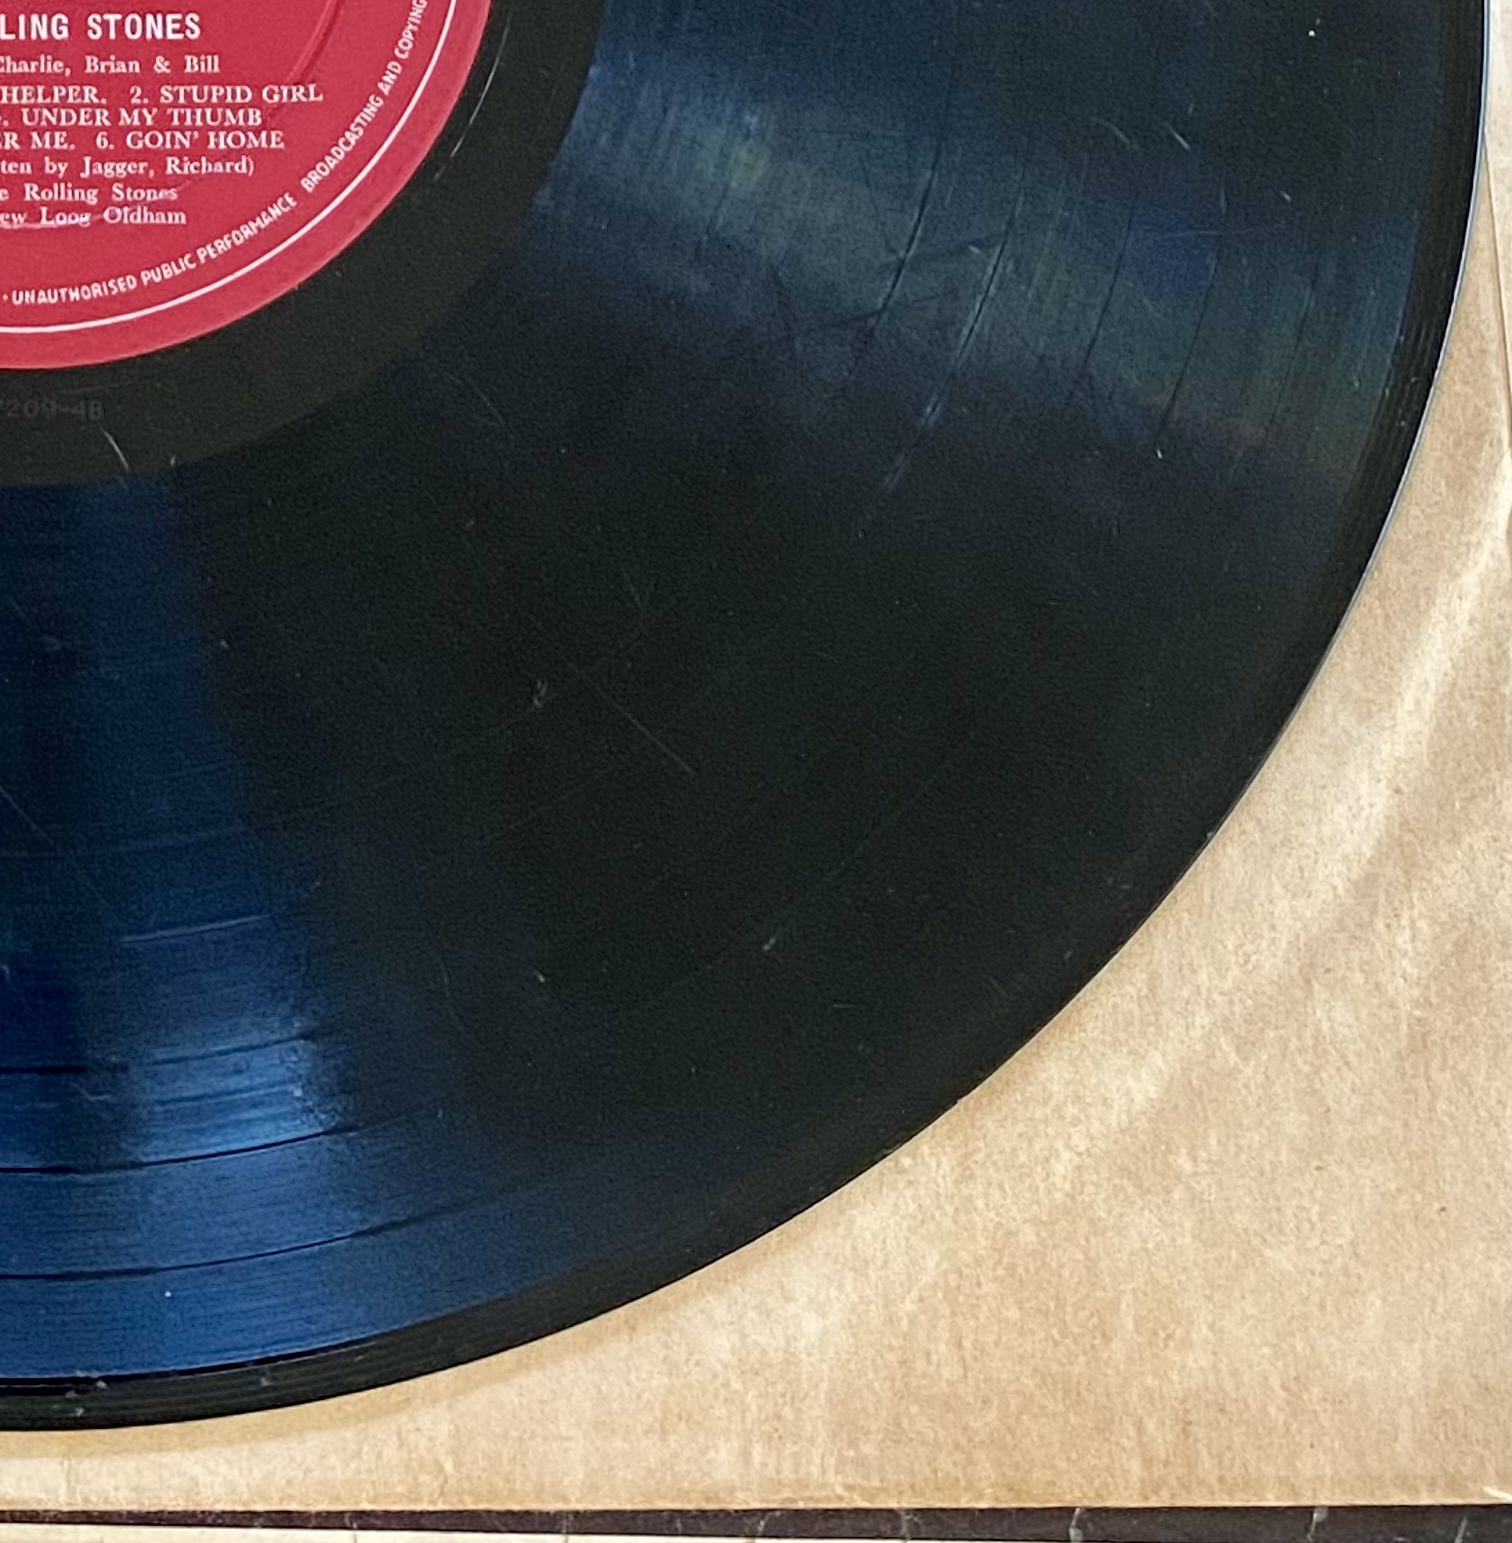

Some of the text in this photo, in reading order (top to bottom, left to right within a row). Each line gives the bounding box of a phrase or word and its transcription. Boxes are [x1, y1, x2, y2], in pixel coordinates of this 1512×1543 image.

[87, 13, 201, 40] STONES
[85, 55, 140, 74] Brian
[153, 55, 171, 73] &
[184, 55, 220, 73] Bill
[0, 85, 107, 105] HELPER.
[129, 85, 148, 104] 2.
[160, 85, 252, 104] STUPID
[262, 84, 323, 104] GIRL
[23, 108, 111, 126] UNDER
[119, 108, 158, 126] MY
[167, 108, 262, 126] THUMB
[300, 93, 384, 193] BROADCASTING
[377, 60, 402, 96] AND
[31, 131, 76, 150] ME.
[96, 131, 114, 150] 6.
[126, 131, 198, 149] GOIN'
[208, 131, 284, 149] HOME
[44, 156, 68, 177] by
[80, 156, 154, 179] Jagger,
[165, 155, 254, 177] Richard)
[23, 183, 98, 205] Rolling
[111, 183, 178, 201] Stones
[40, 207, 91, 226] Loog
[103, 205, 186, 225] Oldham
[11, 274, 137, 305] UNAUTHORISED
[140, 254, 197, 286] PUBLIC
[196, 192, 297, 264] PERFORMANCE
